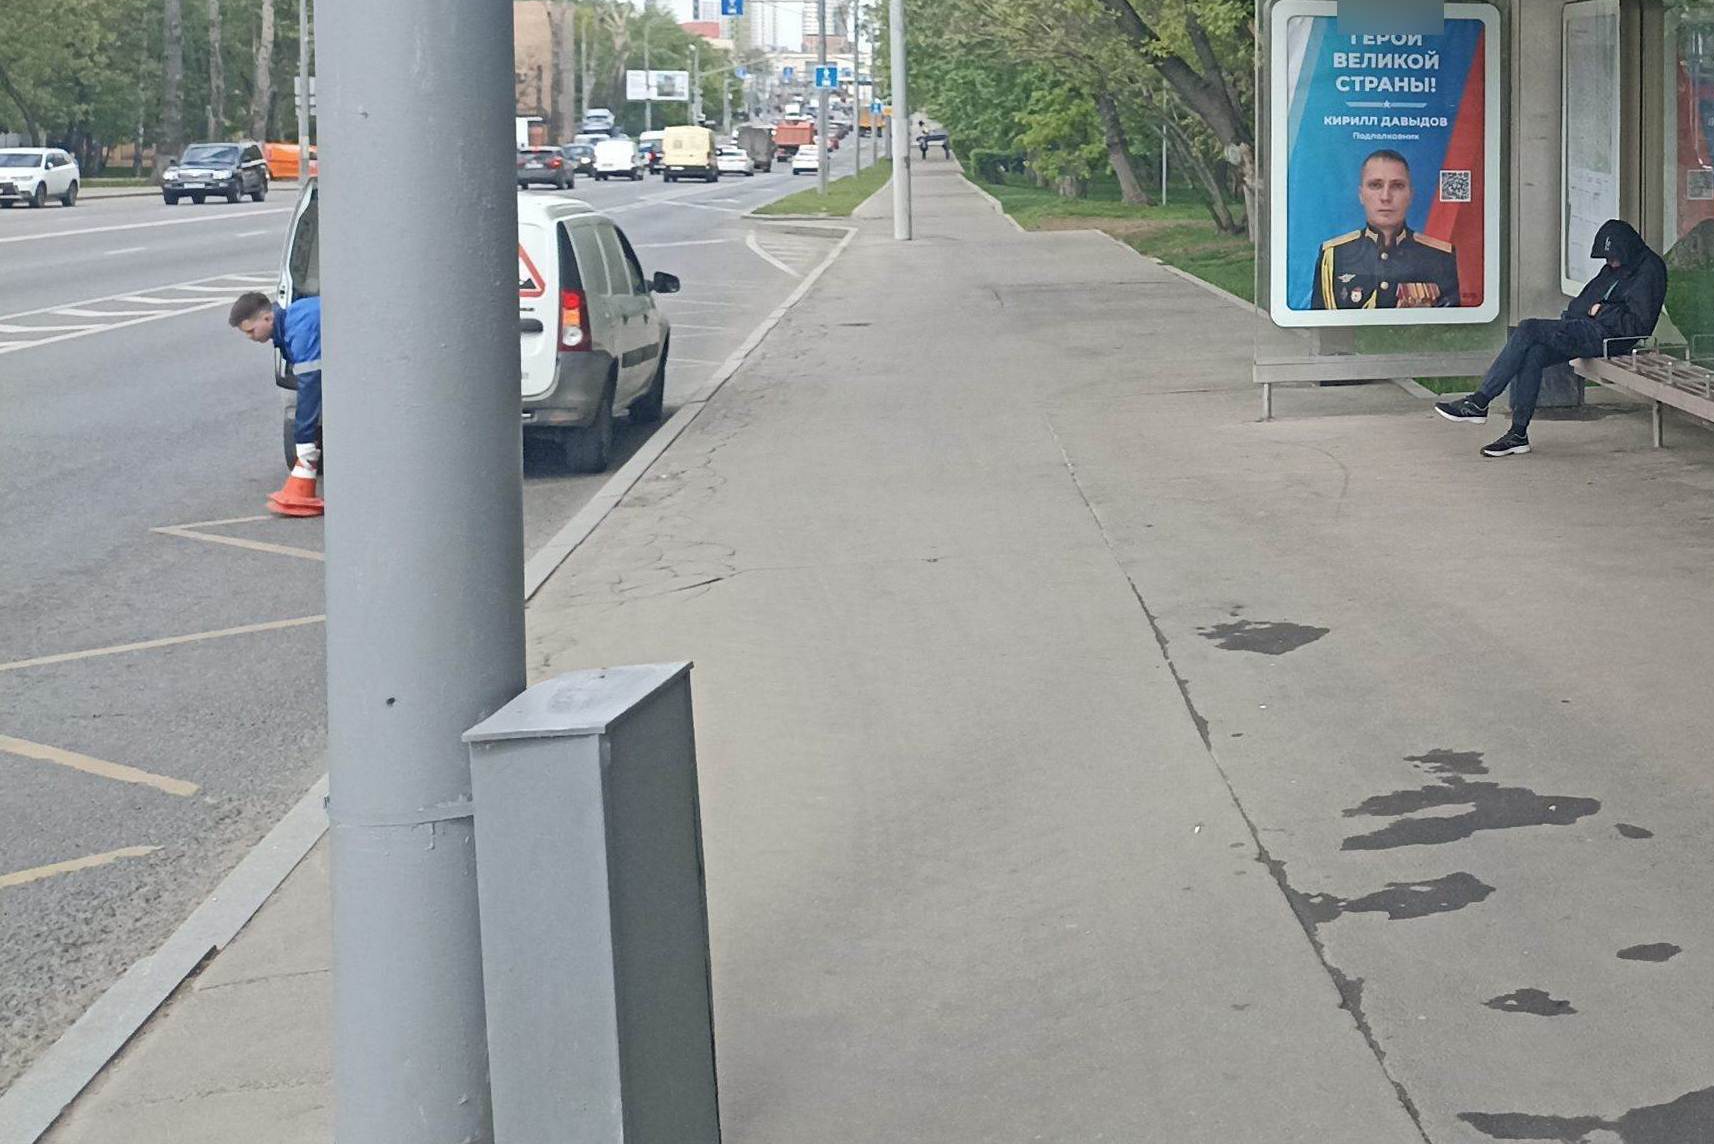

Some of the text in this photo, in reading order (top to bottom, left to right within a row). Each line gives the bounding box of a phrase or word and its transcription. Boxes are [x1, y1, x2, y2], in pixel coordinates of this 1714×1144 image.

[1333, 50, 1440, 70] ВЕЛИКОЙ
[1335, 75, 1437, 93] СТРАНЫ!
[1323, 115, 1449, 128] КИРИЛЛ ДАВЫДОВ
